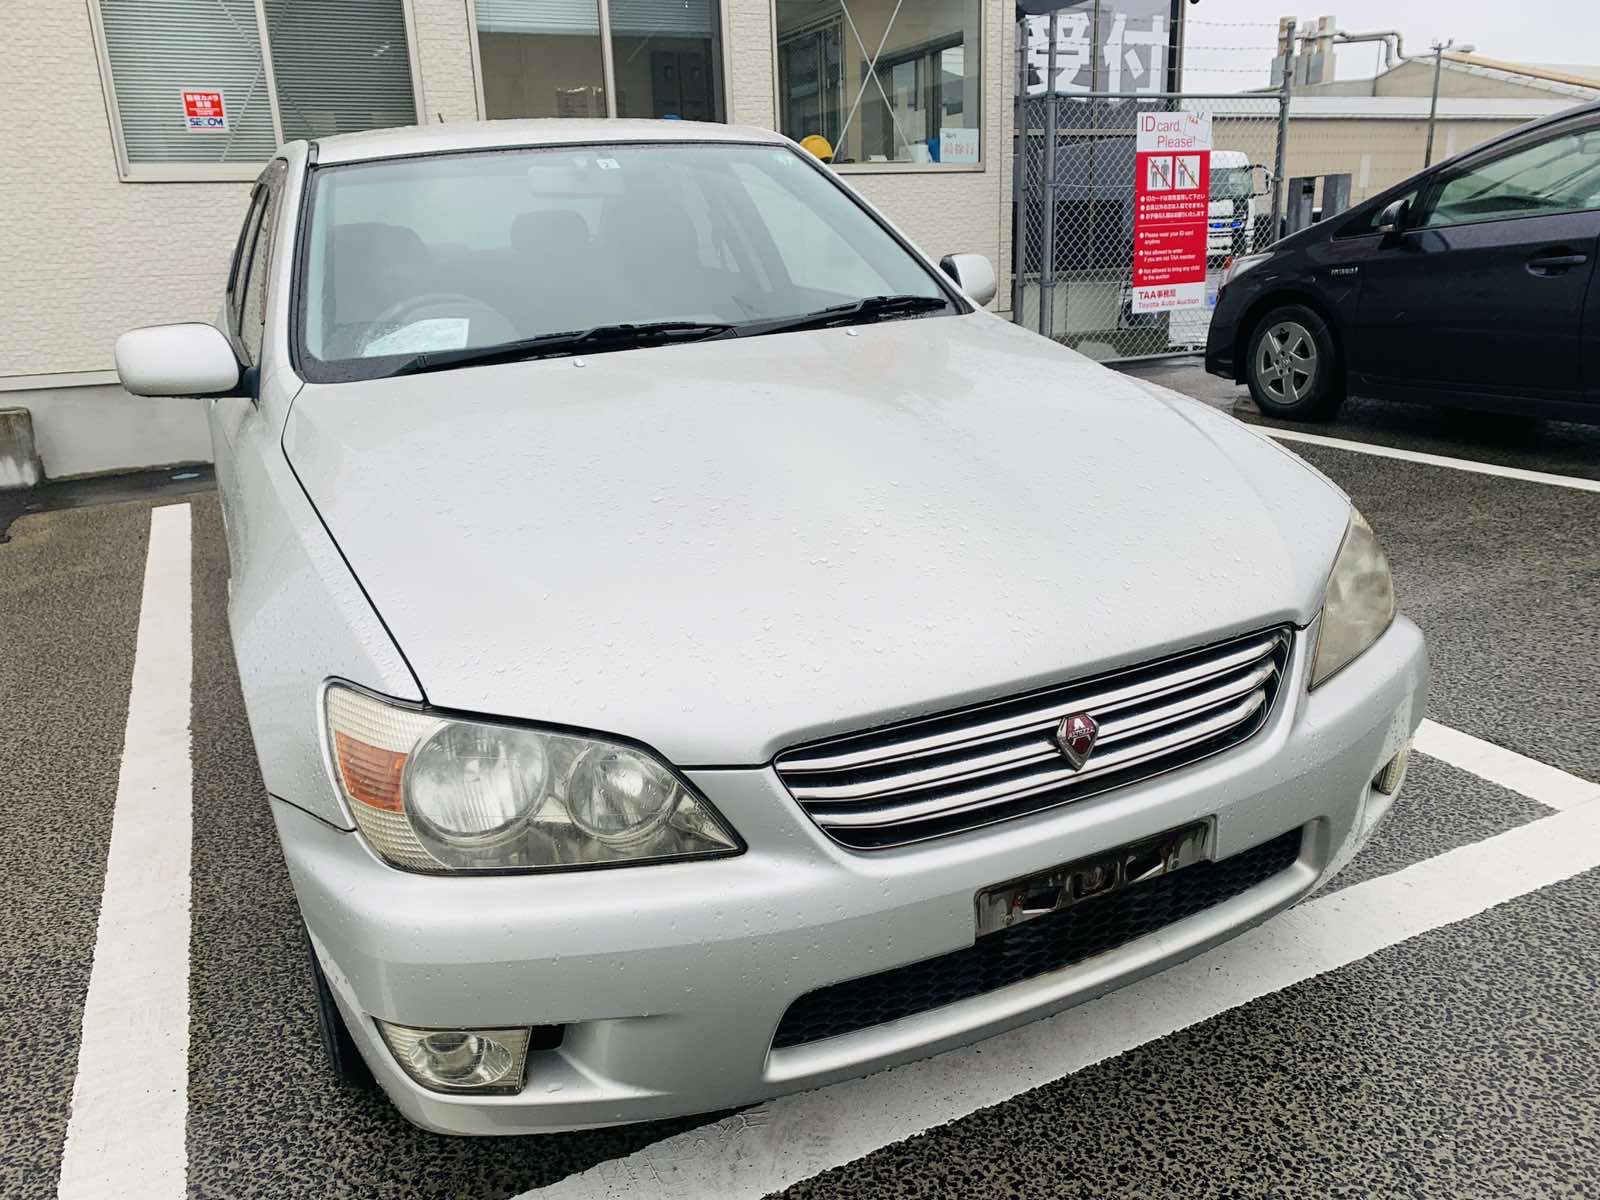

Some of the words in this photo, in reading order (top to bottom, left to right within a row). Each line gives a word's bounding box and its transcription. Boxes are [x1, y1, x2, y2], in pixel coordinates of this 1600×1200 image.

[1025, 12, 1169, 102] 受付
[189, 117, 224, 126] SECOM
[1141, 115, 1156, 132] ID
[1157, 135, 1196, 148] Please!
